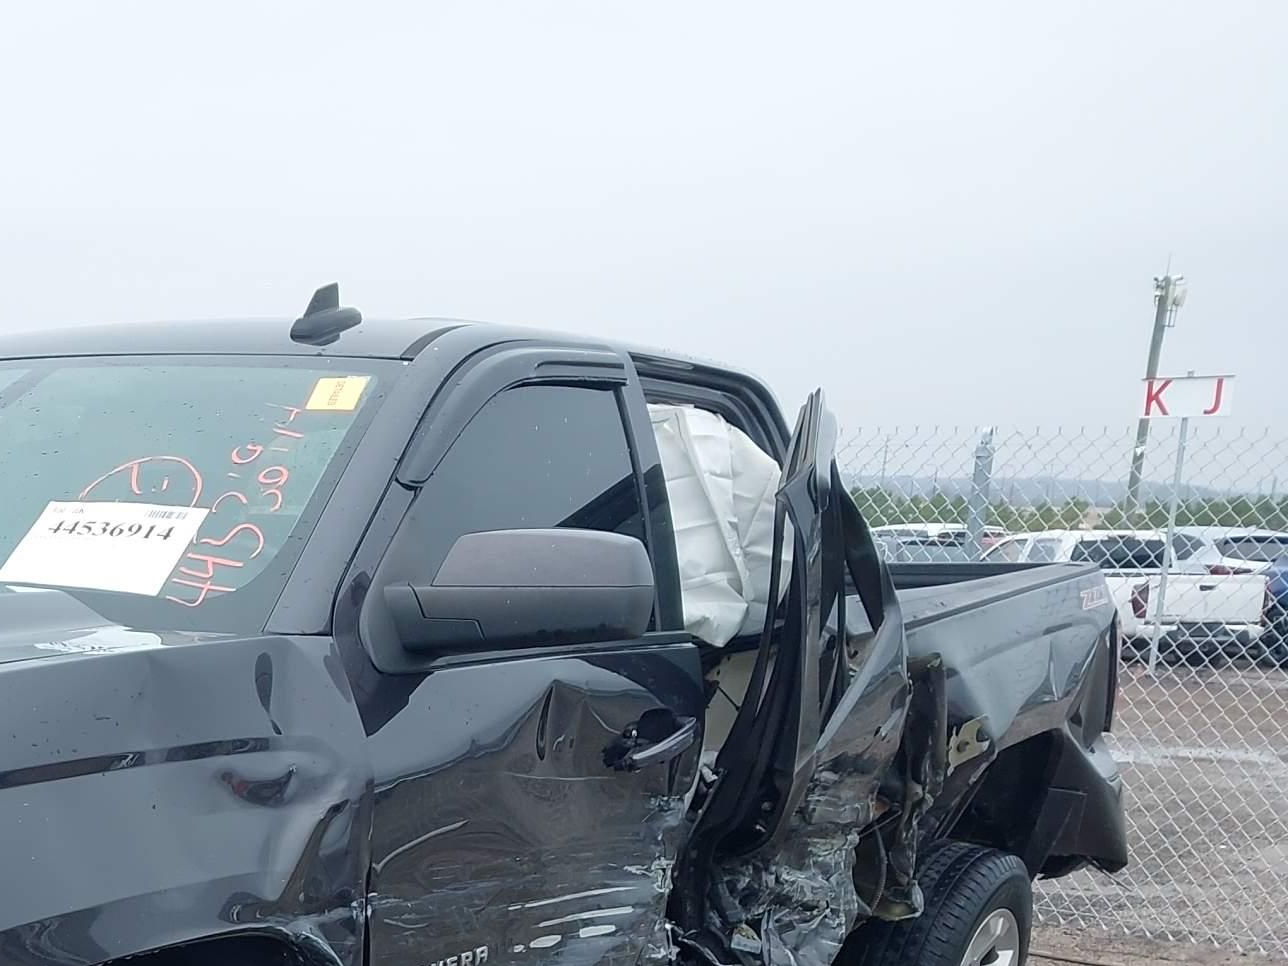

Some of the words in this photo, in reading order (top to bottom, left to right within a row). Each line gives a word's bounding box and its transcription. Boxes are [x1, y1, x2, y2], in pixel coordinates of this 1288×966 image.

[1144, 379, 1173, 416] K
[1203, 378, 1224, 415] J
[48, 520, 175, 540] 44536914
